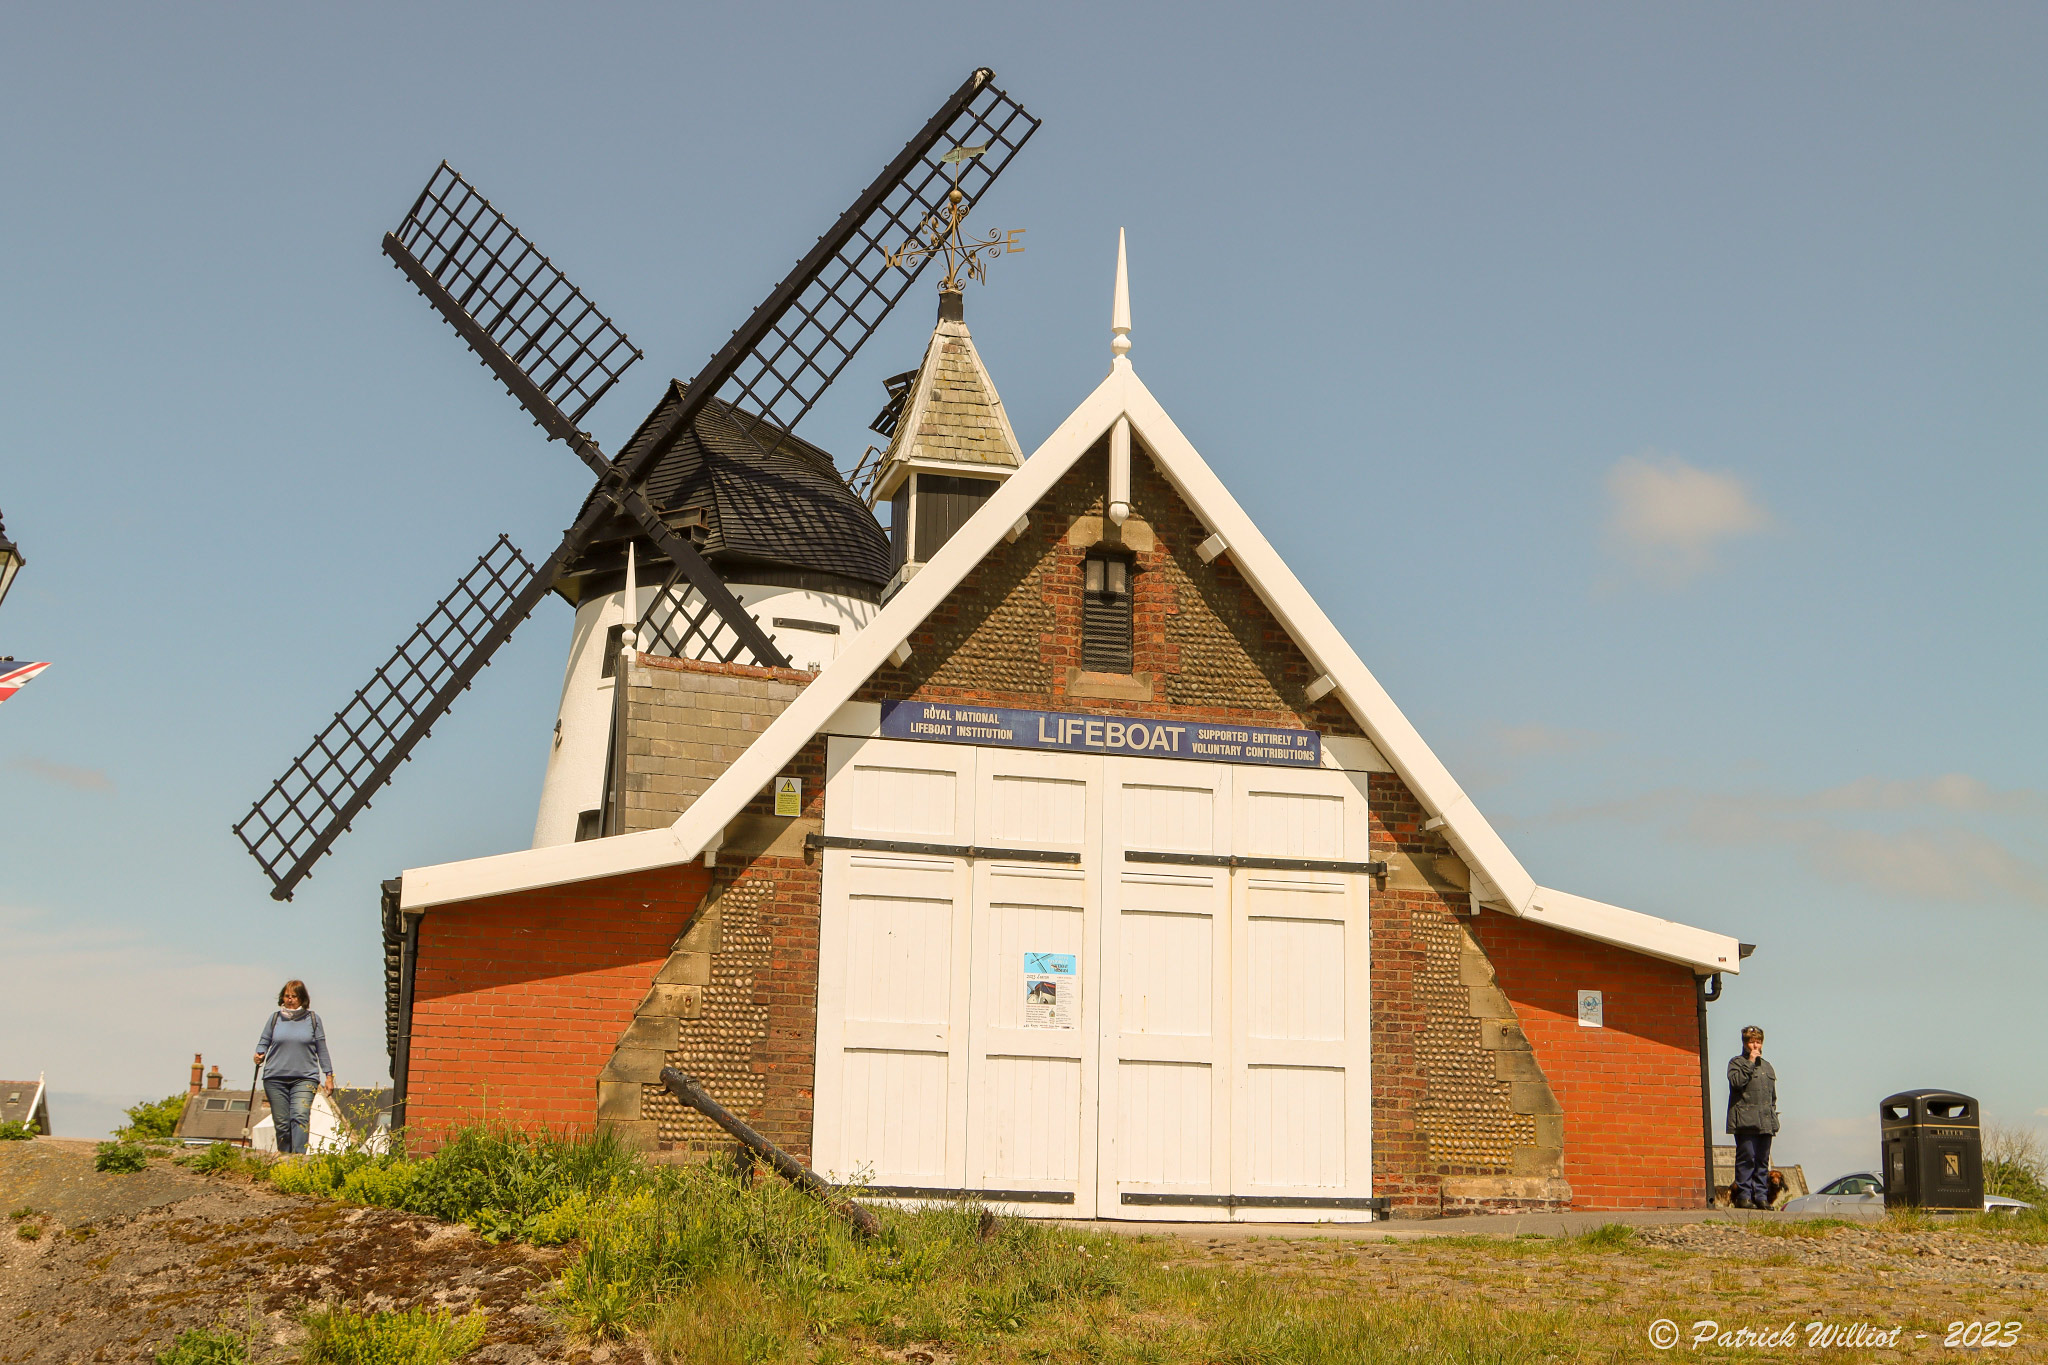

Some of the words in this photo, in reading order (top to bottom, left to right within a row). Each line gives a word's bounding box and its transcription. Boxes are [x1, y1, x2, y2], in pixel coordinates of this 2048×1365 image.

[1006, 229, 1026, 254] E
[884, 244, 907, 268] W
[976, 258, 987, 287] N
[923, 707, 952, 721] ROYAL
[955, 710, 1000, 725] NATIONAL
[910, 722, 952, 737] LIFEBOAT
[956, 725, 1013, 741] INSTITUTION
[1038, 717, 1186, 752] LIFEBOAT
[1198, 729, 1249, 743] SUPPORTED
[1252, 733, 1292, 747] ENTIRELY
[1297, 736, 1308, 747] BY
[1192, 742, 1243, 757] VOLUNTARY
[1245, 745, 1315, 762] CONTRIBUTIONS
